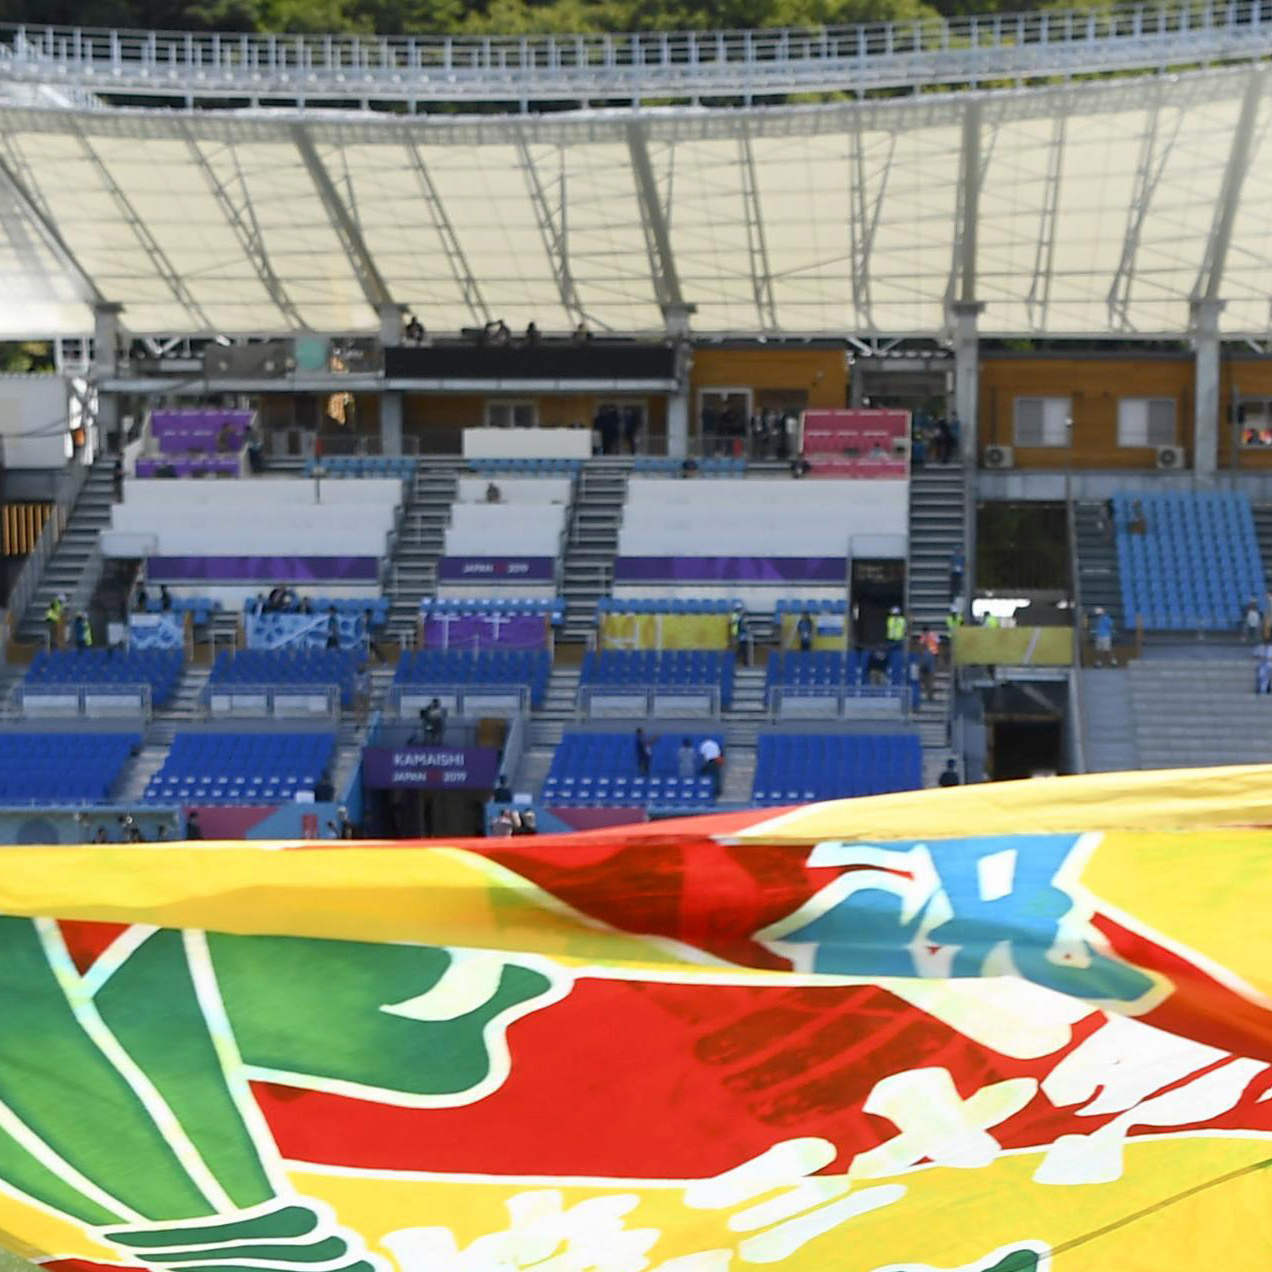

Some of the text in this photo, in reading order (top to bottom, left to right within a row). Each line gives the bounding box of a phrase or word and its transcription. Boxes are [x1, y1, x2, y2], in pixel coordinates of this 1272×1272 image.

[393, 754, 465, 766] KAMAISHI
[392, 771, 467, 782] JAPAN 2019
